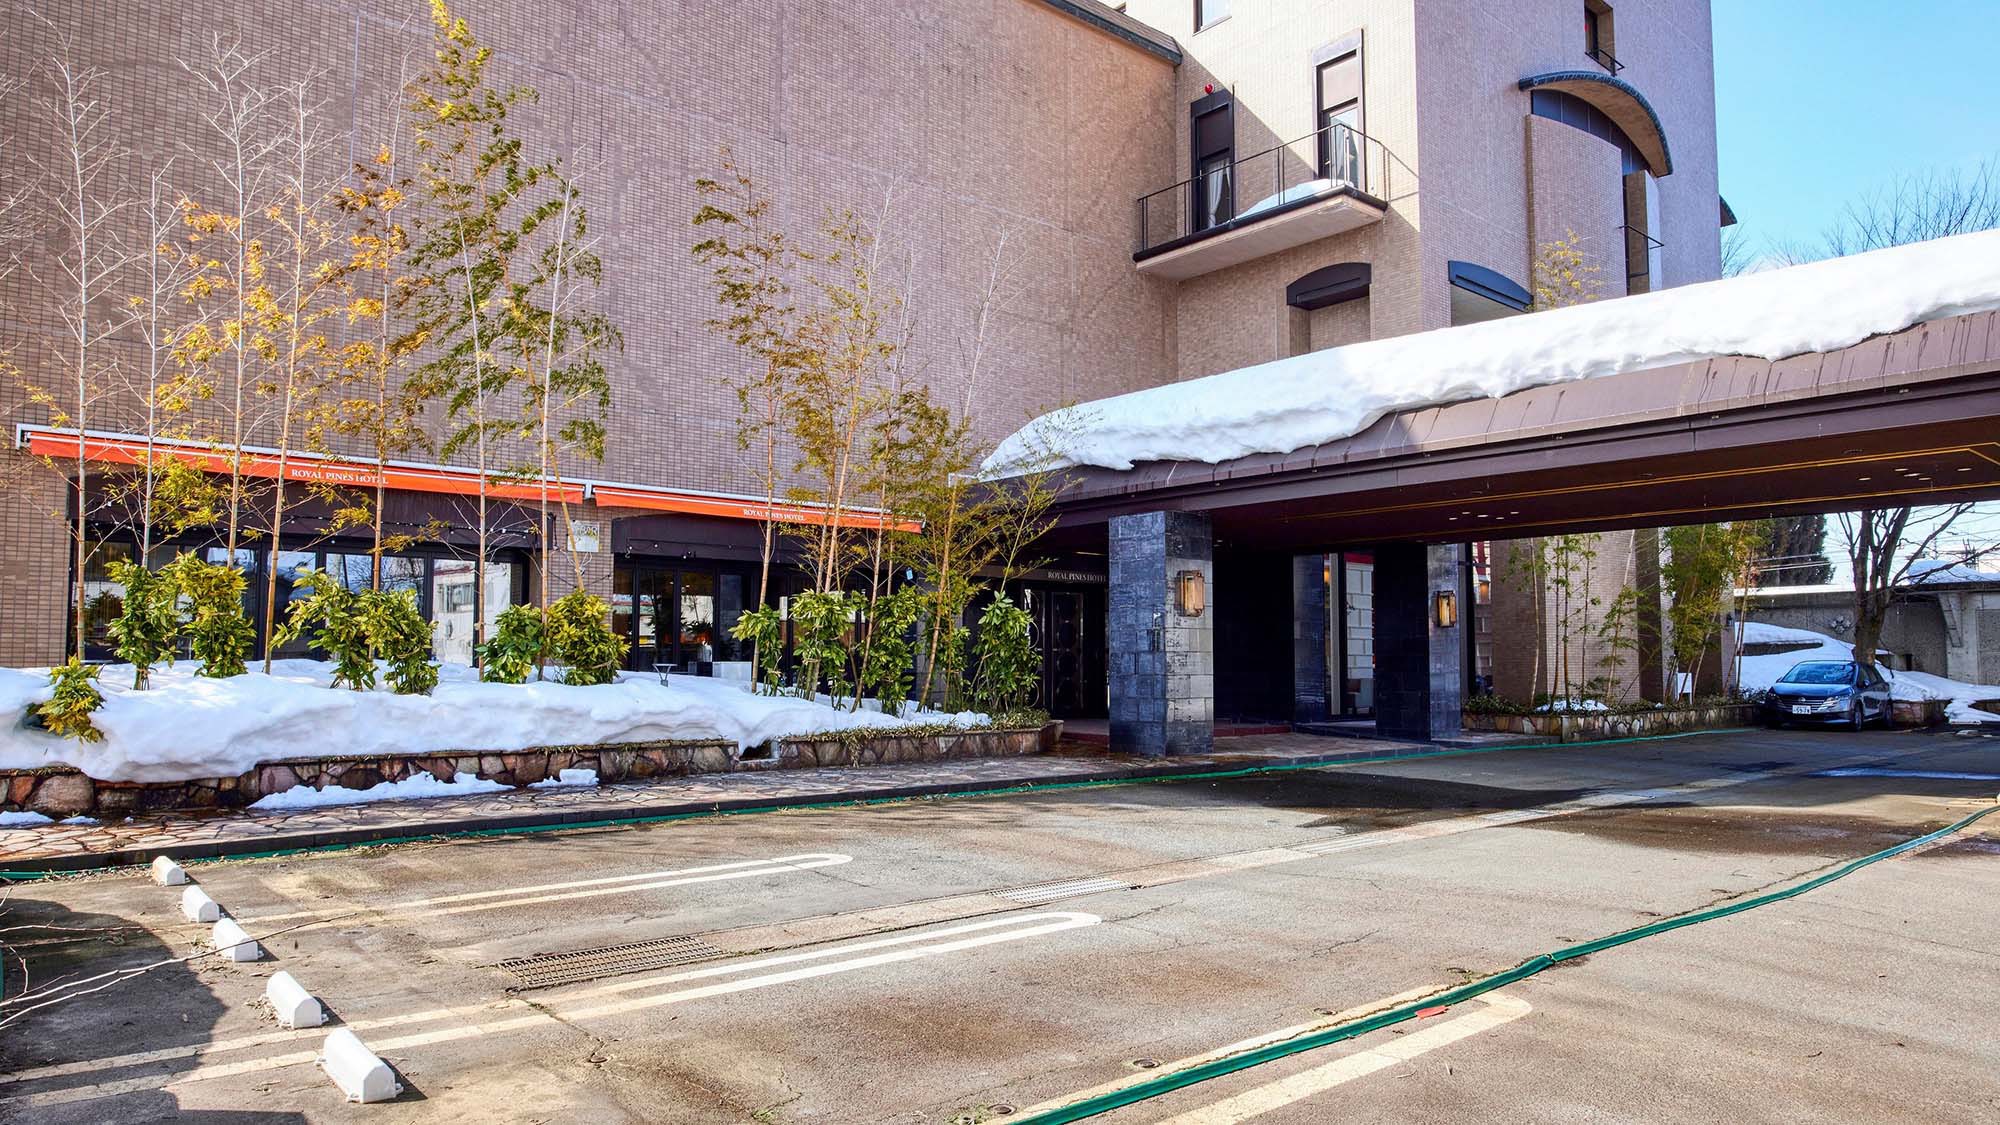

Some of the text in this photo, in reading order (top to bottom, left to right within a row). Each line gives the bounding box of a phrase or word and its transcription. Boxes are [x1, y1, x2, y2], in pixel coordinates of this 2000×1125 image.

[291, 469, 324, 480] ROYAL
[326, 472, 353, 482] PINES
[743, 509, 764, 517] ROYAL
[1047, 571, 1068, 580] ROYAL
[1069, 572, 1087, 580] PINES
